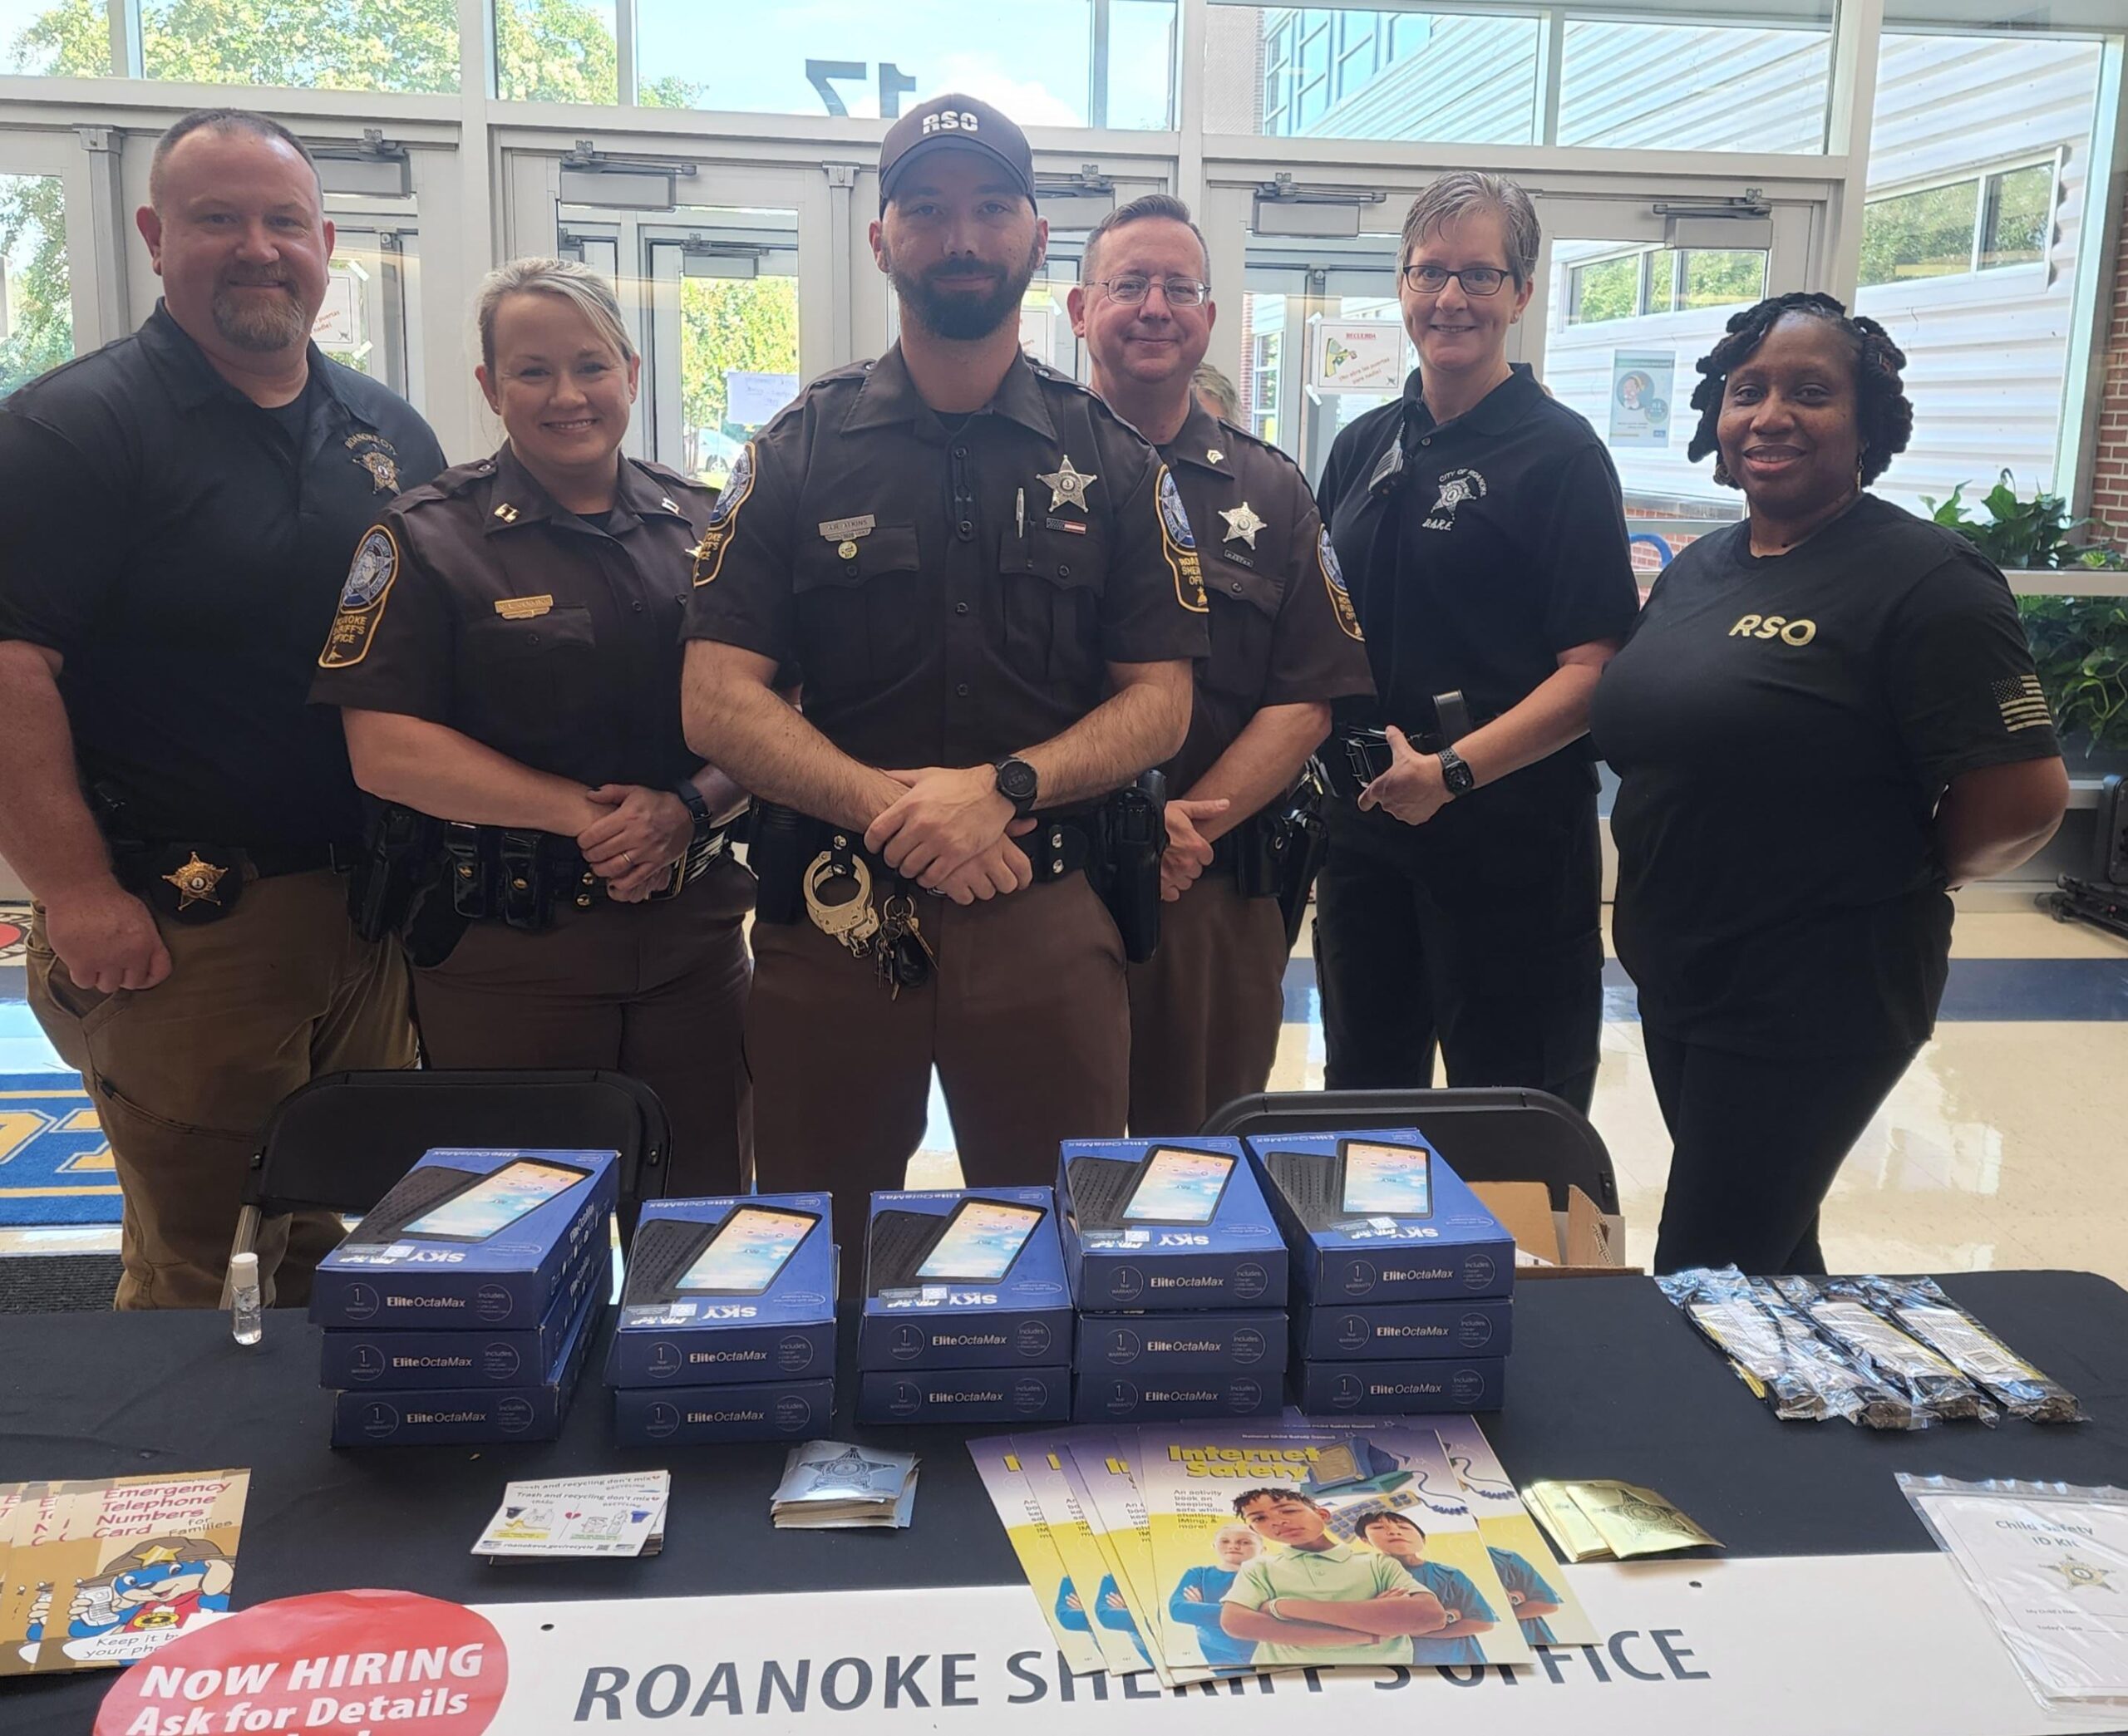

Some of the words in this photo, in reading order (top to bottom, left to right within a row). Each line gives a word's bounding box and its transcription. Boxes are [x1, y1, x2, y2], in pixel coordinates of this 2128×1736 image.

[923, 111, 978, 134] RSO
[345, 433, 379, 450] ROANOKE
[1439, 470, 1456, 482] CITY
[1467, 470, 1486, 498] ROANOKE
[1728, 614, 1816, 647] RSO
[1159, 1234, 1209, 1246] SKY
[408, 1252, 466, 1263] SKY
[1150, 1276, 1224, 1287] EliteOctaMax
[1383, 1269, 1453, 1281] EliteOctaMax
[387, 1296, 466, 1308] EliteOctaMax
[949, 1294, 998, 1306] SKY
[703, 1306, 757, 1319] SKY
[1377, 1326, 1449, 1337] EliteOctaMax
[932, 1335, 1007, 1345] EliteOctaMax
[1147, 1341, 1221, 1351] EliteOctaMax
[392, 1357, 472, 1368] EliteOctaMax
[689, 1350, 766, 1363] EliteOctaMax
[1370, 1384, 1442, 1395] EliteOctaMax
[929, 1392, 1003, 1403] EliteOctaMax
[1145, 1391, 1219, 1402] EliteOctaMax
[406, 1412, 486, 1424] EliteOctaMax
[687, 1410, 765, 1423] EliteOctaMax
[1167, 1444, 1321, 1463] Internet
[1186, 1460, 1309, 1483] Safety
[562, 1479, 605, 1490] recycling
[607, 1477, 631, 1485] don't
[103, 1481, 232, 1500] Emergency
[101, 1495, 217, 1512] Telephone
[96, 1507, 204, 1526] Numbers
[93, 1524, 152, 1538] Card
[168, 1521, 233, 1537] Families
[1996, 1520, 2037, 1531] Child
[2032, 1537, 2051, 1546] ID
[96, 1634, 140, 1648] Keep
[145, 1633, 157, 1642] it
[85, 1647, 128, 1659] your
[139, 1662, 279, 1701] NOW
[287, 1642, 484, 1691] HIRING
[574, 1651, 978, 1722] ROANOKE
[125, 1705, 216, 1736] Ask
[224, 1702, 298, 1730] for
[304, 1688, 469, 1725] Details
